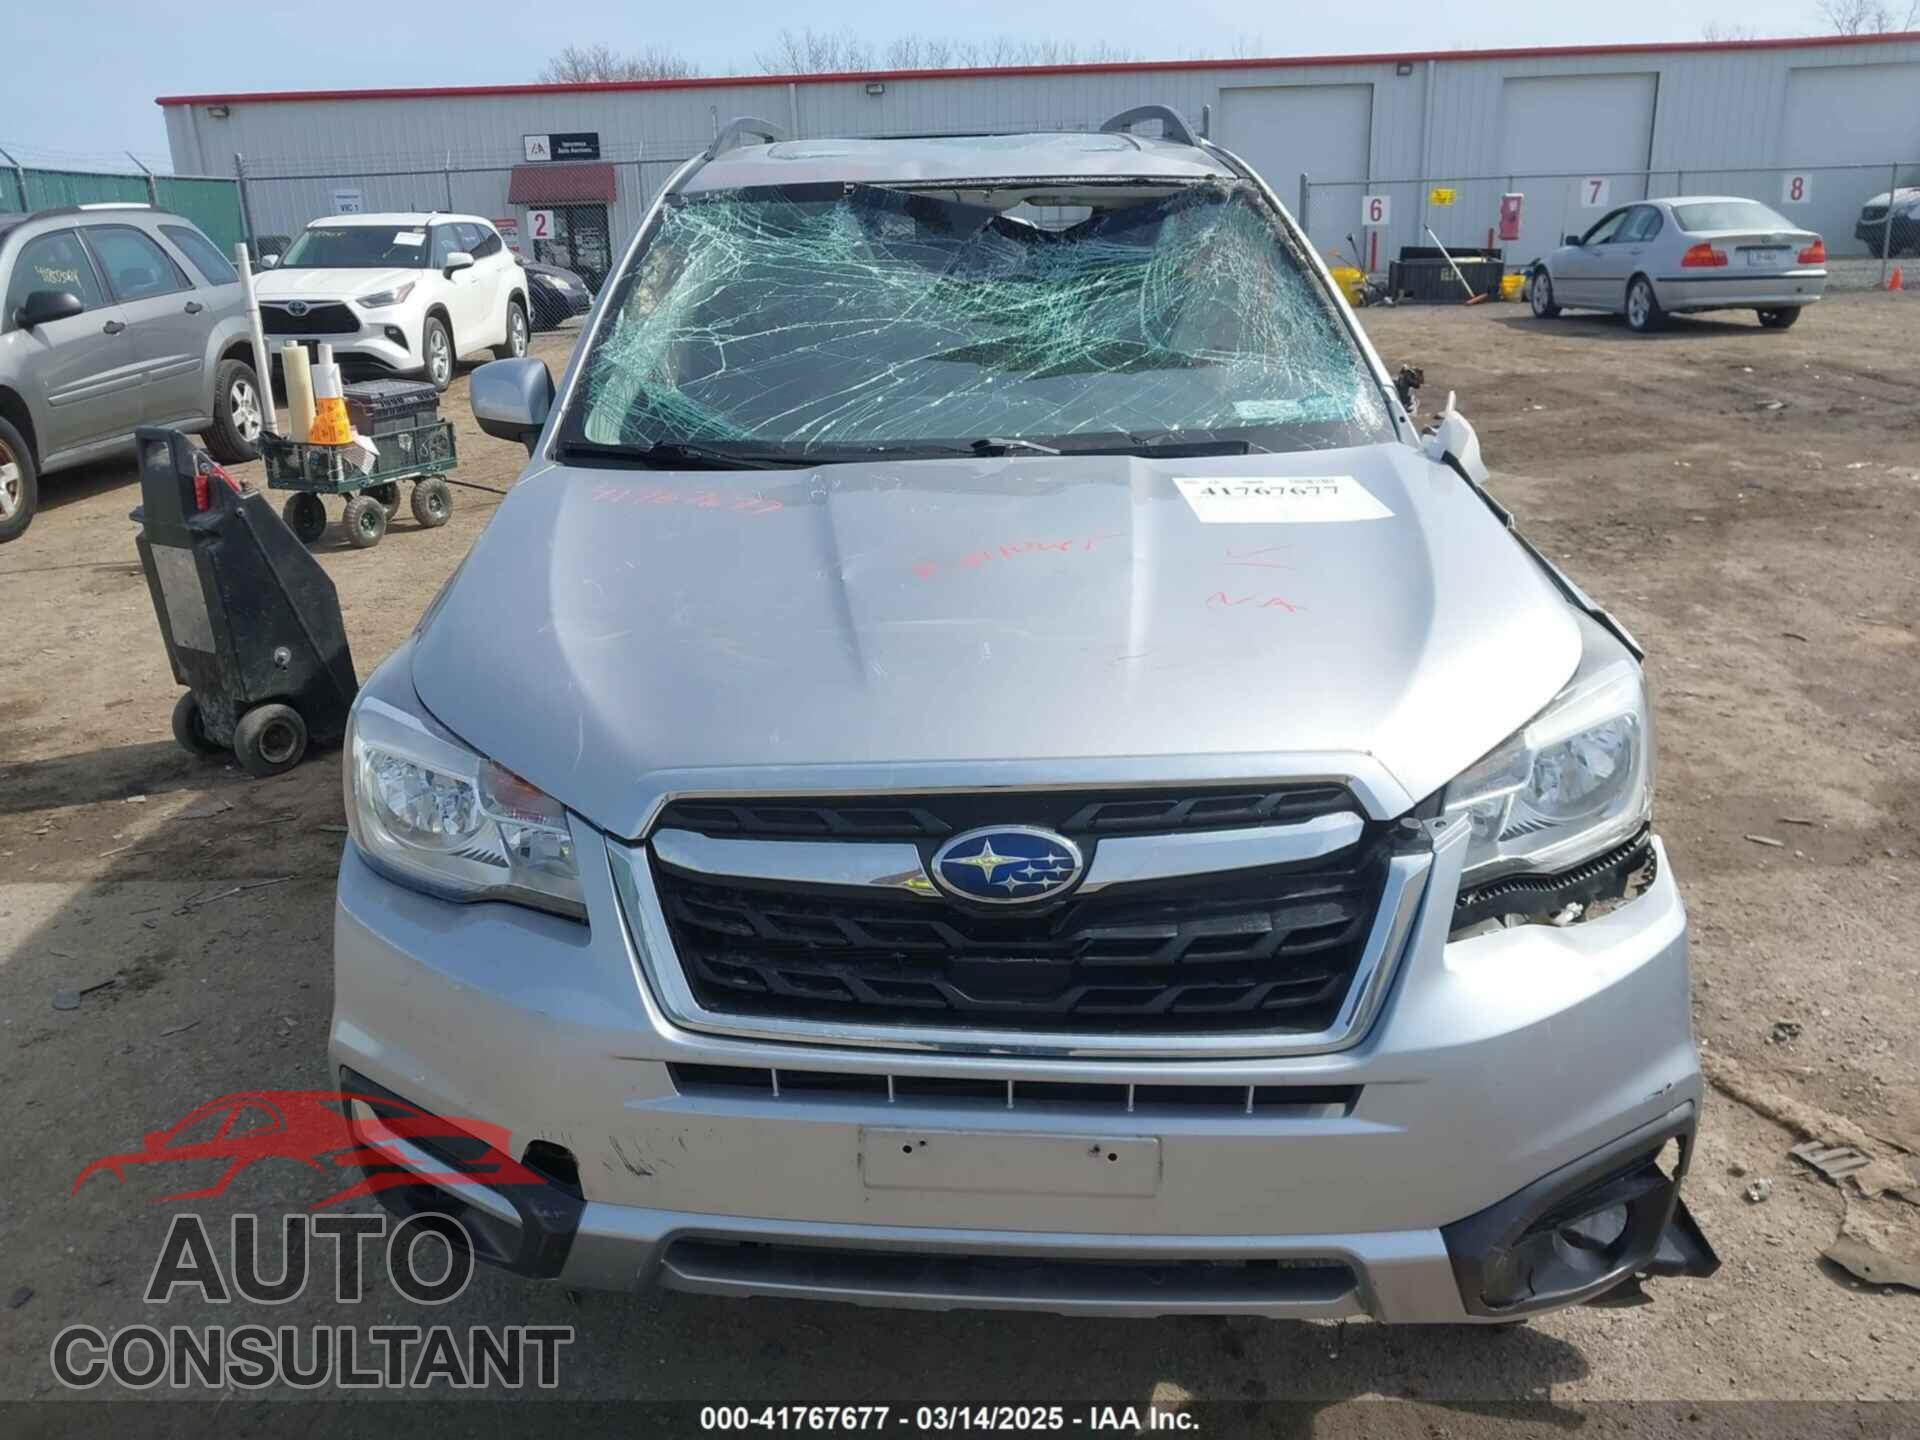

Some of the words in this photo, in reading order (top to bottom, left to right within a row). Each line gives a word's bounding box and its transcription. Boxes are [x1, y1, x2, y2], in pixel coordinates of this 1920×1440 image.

[1588, 180, 1603, 204] 7
[1790, 176, 1804, 201] 8
[1369, 197, 1382, 222] 6
[534, 213, 548, 237] 2
[1200, 485, 1340, 497] 41767677
